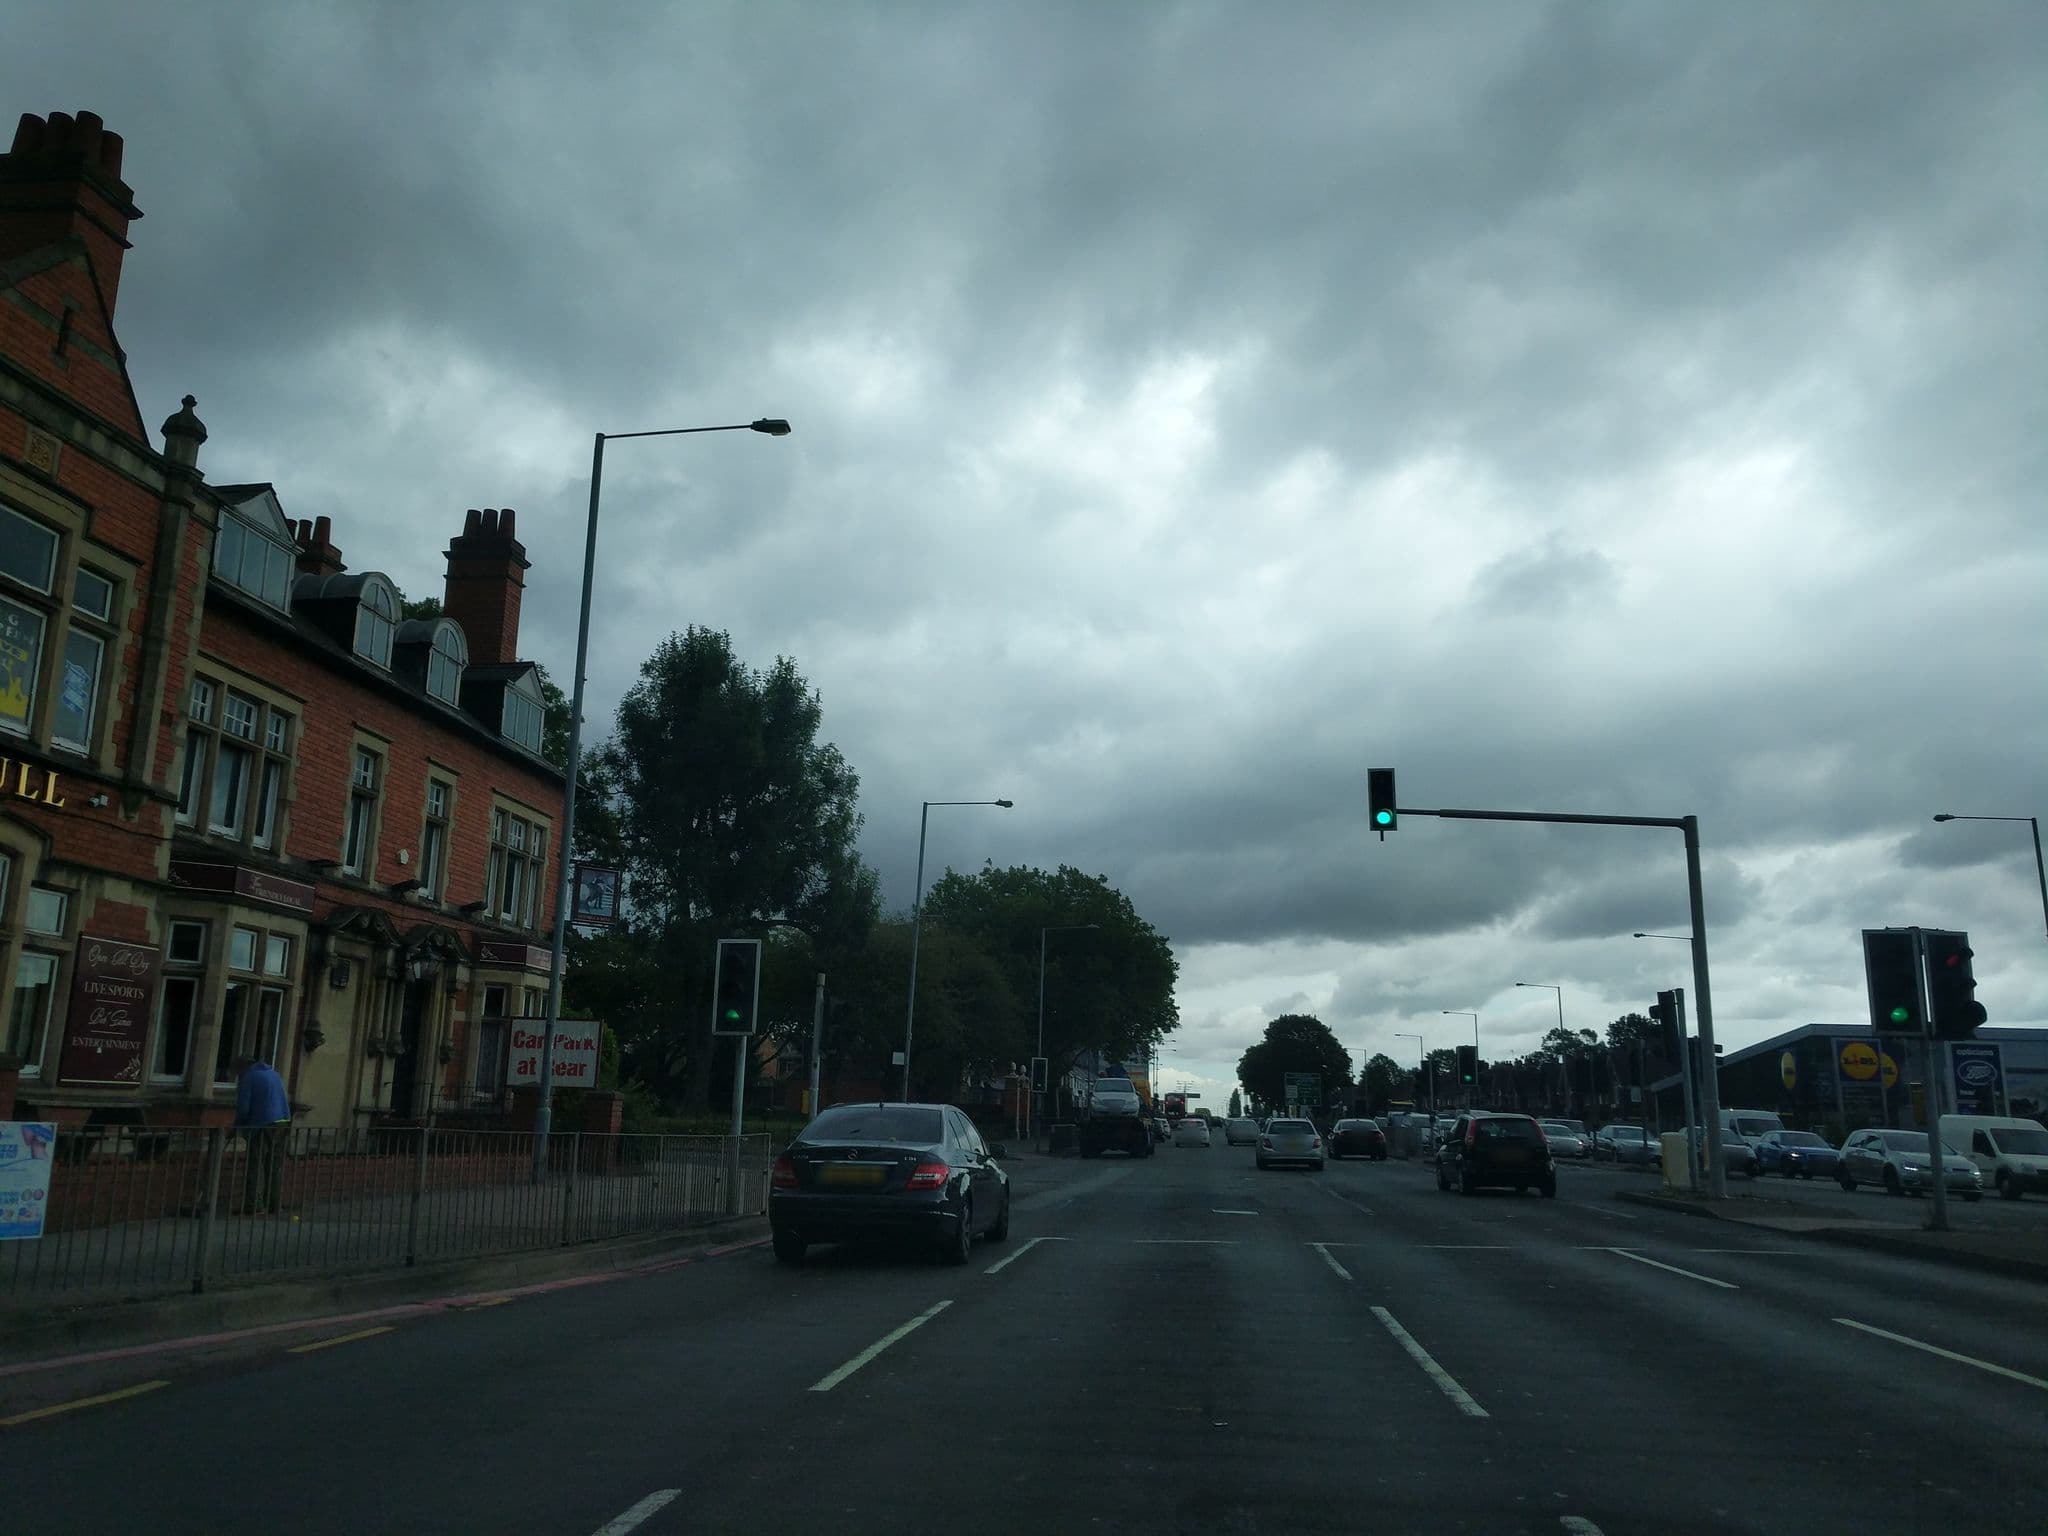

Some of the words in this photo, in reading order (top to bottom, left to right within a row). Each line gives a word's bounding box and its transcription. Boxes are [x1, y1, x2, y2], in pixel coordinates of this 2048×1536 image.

[84, 981, 107, 995] LIVE
[107, 985, 145, 1000] SPORTS
[72, 1036, 142, 1050] ENTERTAINMENT
[513, 1030, 544, 1049] Car
[517, 1057, 537, 1075] at
[551, 1060, 587, 1077] ear
